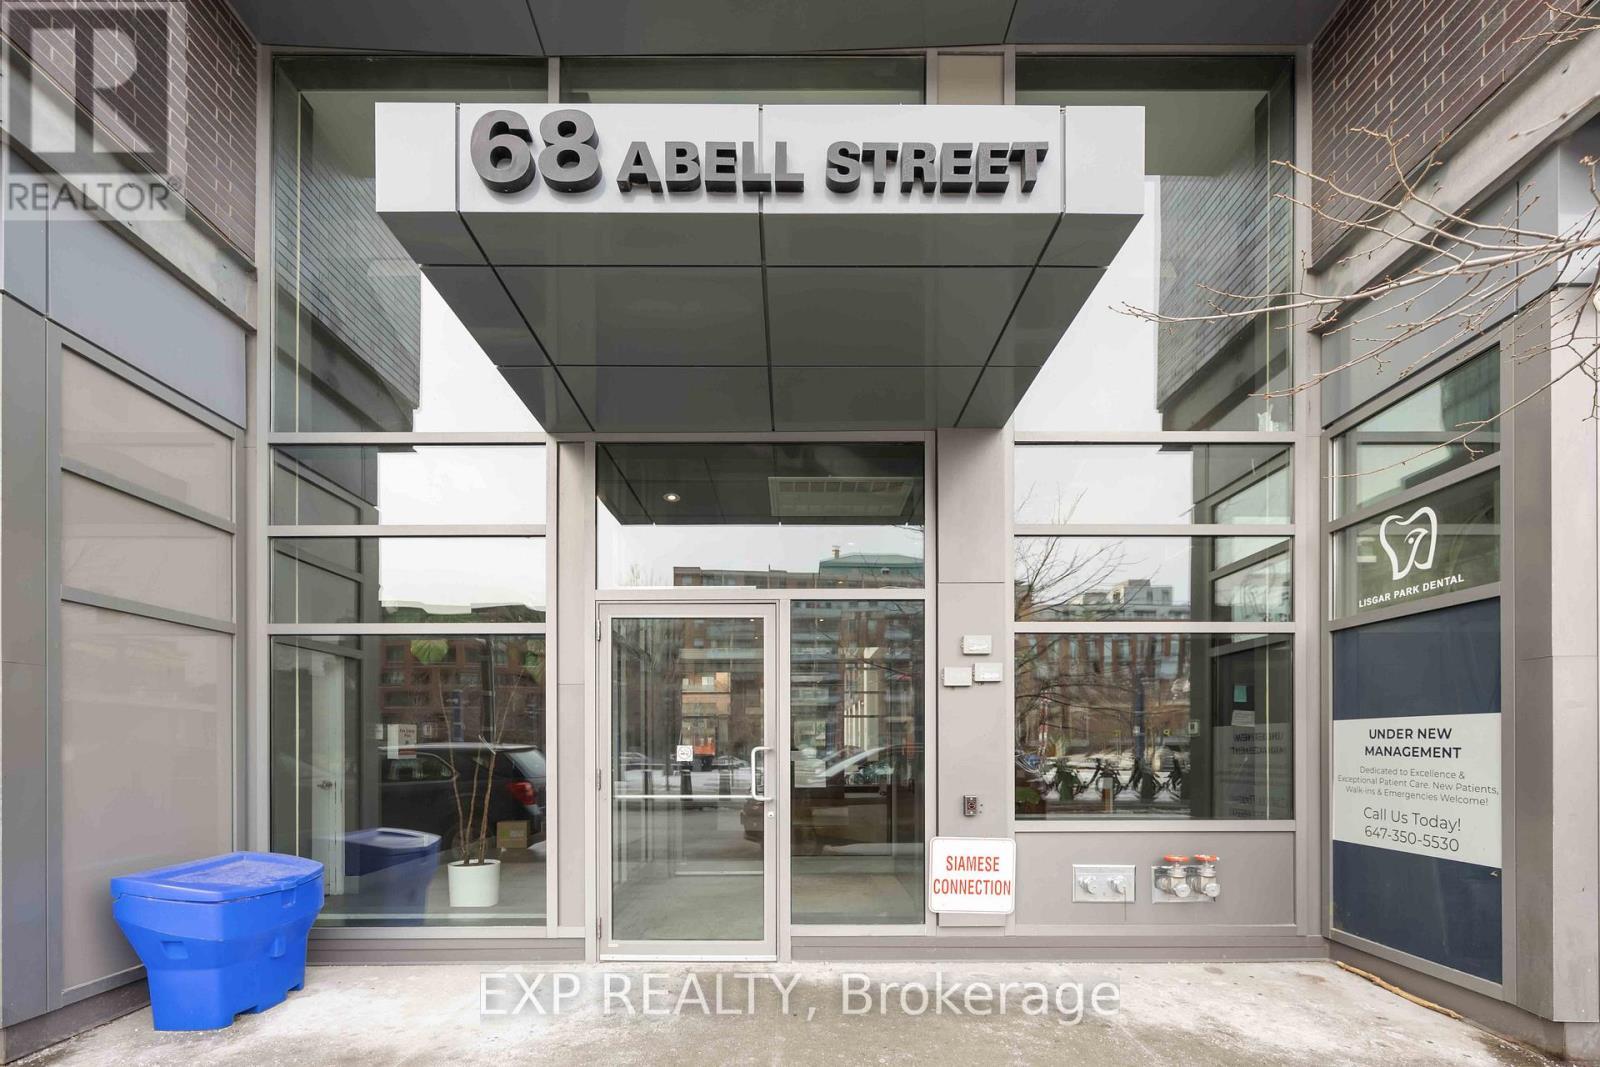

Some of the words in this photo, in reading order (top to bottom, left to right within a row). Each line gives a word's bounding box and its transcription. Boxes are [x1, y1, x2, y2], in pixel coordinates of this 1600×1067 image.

[470, 109, 603, 194] 68
[617, 141, 804, 194] ABELL
[826, 141, 1049, 194] STREET
[1358, 592, 1391, 608] LISGAR
[1393, 584, 1420, 599] PARK
[1422, 574, 1465, 592] DENTAL
[1369, 728, 1413, 740] UNDER
[1417, 728, 1453, 740] NEW
[1364, 746, 1462, 759] MANAGEMENT
[1359, 765, 1398, 776] Dedicated
[1399, 768, 1409, 776] to
[1410, 768, 1457, 779] Excellence
[1458, 770, 1465, 780] &
[1337, 774, 1378, 785] Exceptional
[1379, 777, 1407, 787] Patient
[1432, 781, 1454, 791] New
[1455, 782, 1499, 796] Patients,
[1345, 785, 1376, 795] Walk-ins
[1376, 788, 1383, 796] &
[1383, 788, 1438, 801] Emergencies
[1440, 793, 1489, 806] Welcome!
[1363, 806, 1387, 821] Call
[1391, 810, 1408, 824] Us
[1411, 812, 1462, 834] Today!
[1364, 825, 1460, 852] 647-350-5530
[945, 855, 1000, 873] SIAMESE
[933, 878, 1011, 896] CONNECTION
